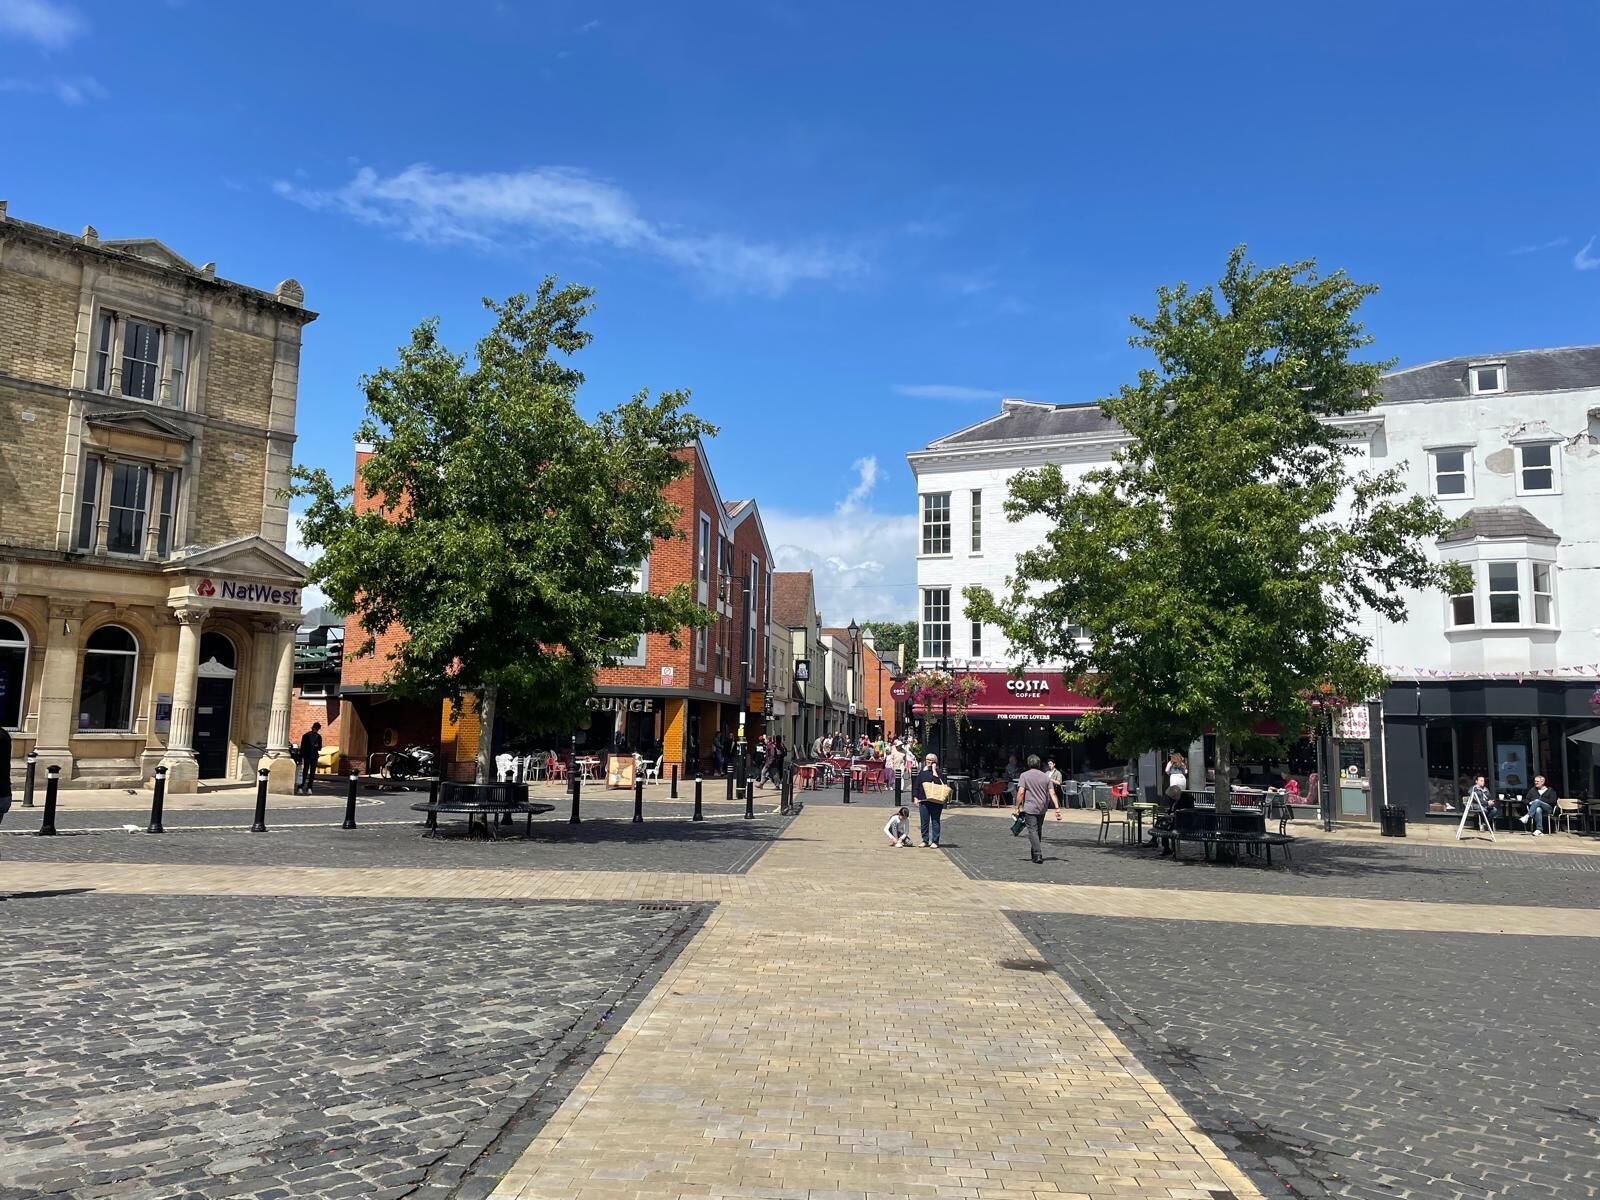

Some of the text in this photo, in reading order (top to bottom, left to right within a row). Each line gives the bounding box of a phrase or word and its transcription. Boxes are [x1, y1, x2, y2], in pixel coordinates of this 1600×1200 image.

[221, 580, 298, 605] NatWest
[1006, 680, 1050, 691] COSTA
[585, 697, 653, 712] OUNGE
